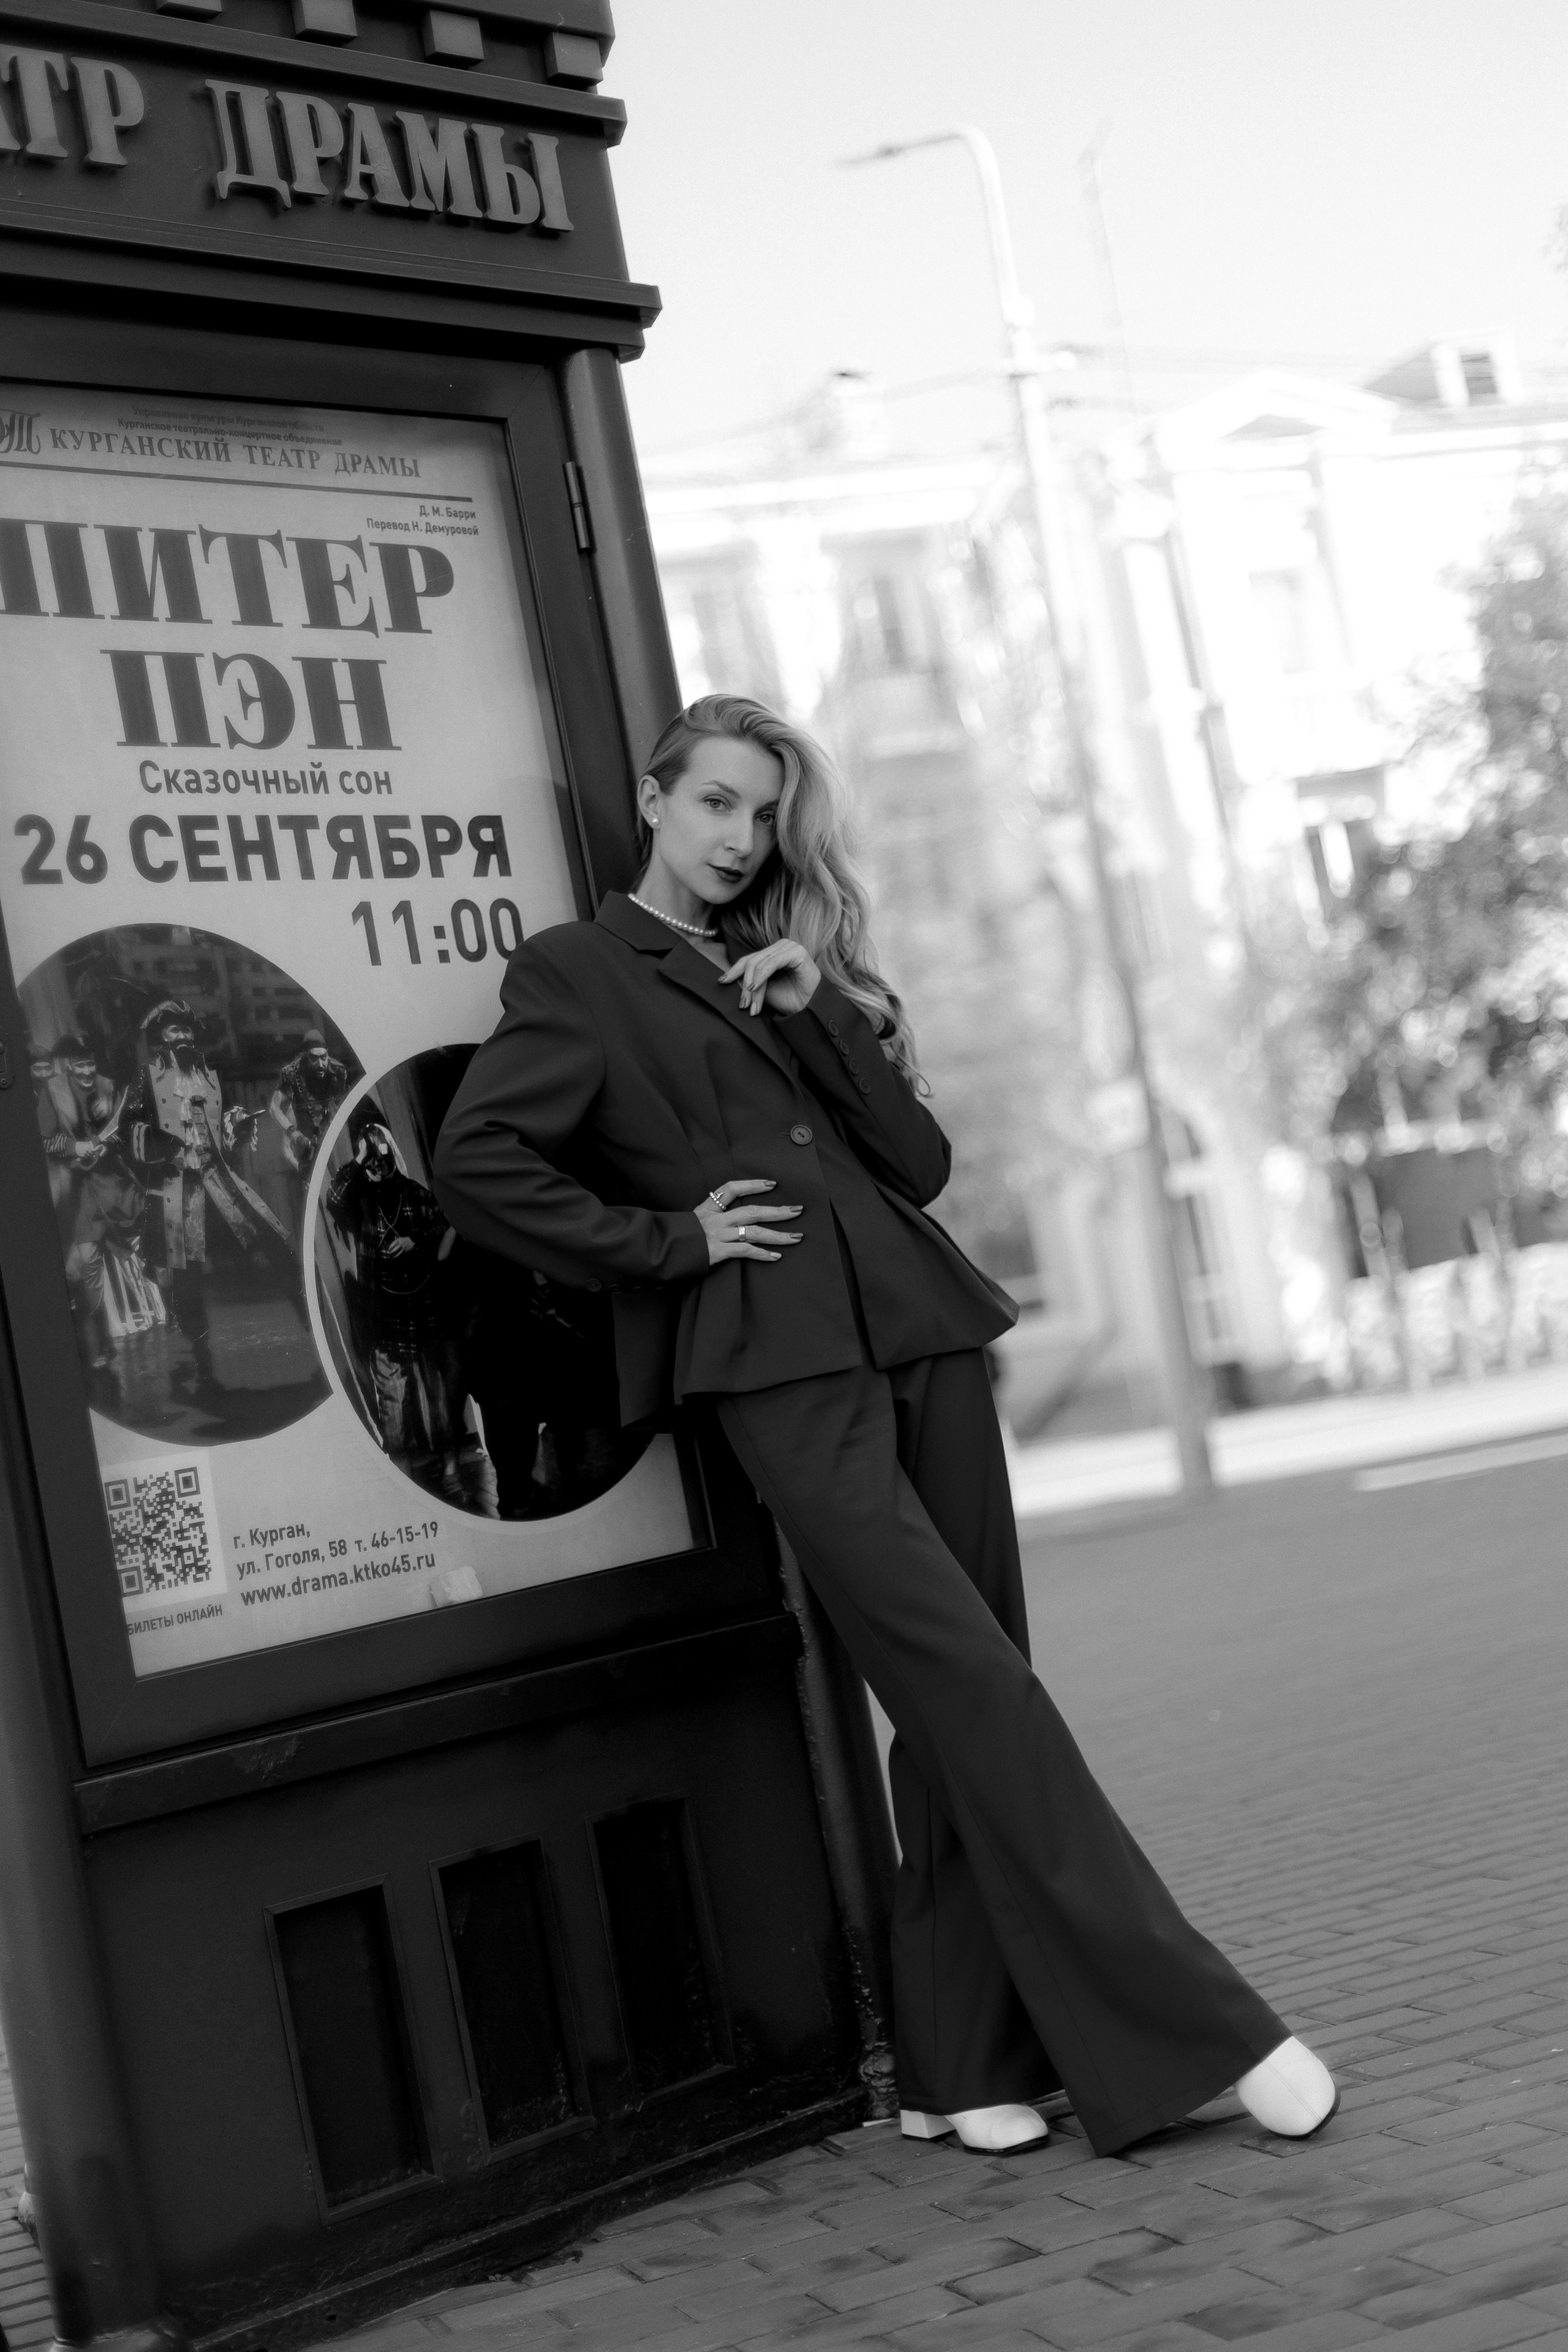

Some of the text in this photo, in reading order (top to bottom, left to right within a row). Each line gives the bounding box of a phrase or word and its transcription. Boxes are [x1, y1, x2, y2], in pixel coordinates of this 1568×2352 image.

[0, 43, 574, 232] ТР ДРАМЫ
[49, 428, 232, 462] КУРГАНСКИЙ
[243, 445, 321, 470] ТЕАТР
[334, 452, 422, 478] ДРАМЫ
[118, 418, 342, 446] Курганское театрально-концертное объединение
[367, 518, 480, 537] Перевод Н. Демуровой
[420, 505, 477, 520] Д. М. Барри
[0, 518, 454, 638] ПИТЕР
[100, 649, 402, 751] ПЭН
[139, 760, 393, 795] Сказочный сон
[13, 813, 512, 885] 26 СЕНТЯБРЯ
[351, 897, 524, 967] 11:00
[233, 1522, 311, 1550] г. Курган,
[236, 1520, 439, 1580] ул. Гоголя, 58 т. 46-15-19
[241, 1551, 436, 1607] www.drama.ktko45.ru
[127, 1603, 223, 1636] БИЛЕТЫ ОНЛАЙН
